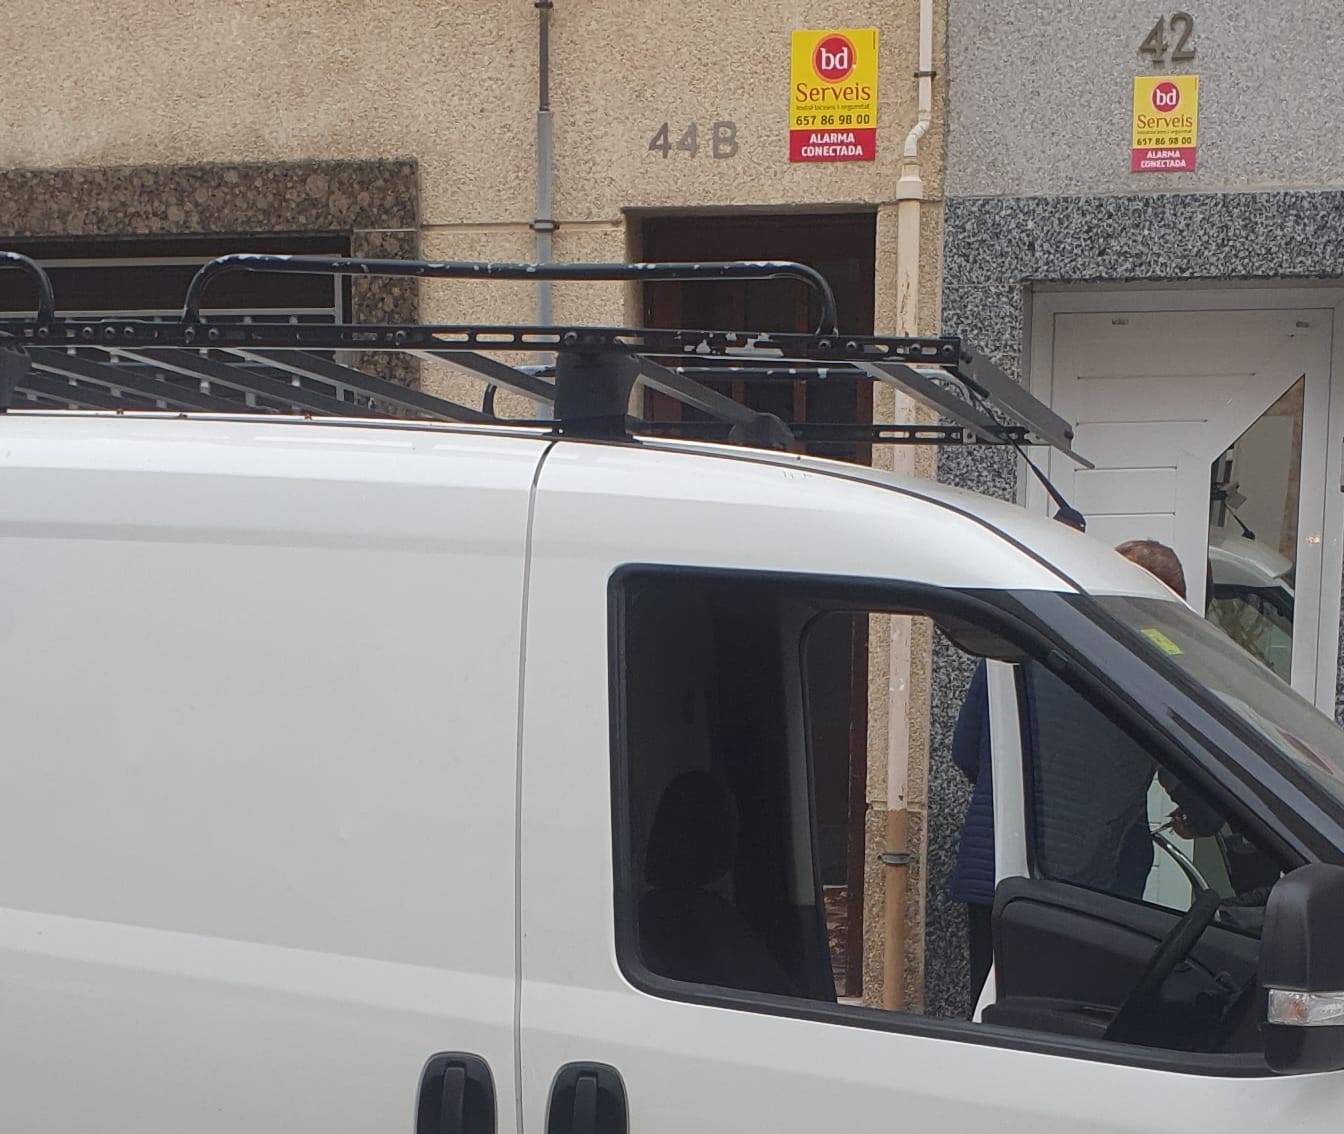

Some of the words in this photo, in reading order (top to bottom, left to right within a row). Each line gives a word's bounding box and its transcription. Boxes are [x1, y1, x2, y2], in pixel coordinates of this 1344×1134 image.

[1138, 10, 1197, 63] 42
[795, 82, 872, 103] Serveis
[795, 115, 817, 126] 657
[820, 114, 835, 125] 86
[838, 114, 853, 125] 98
[856, 113, 870, 125] 00
[1136, 113, 1193, 129] Serveis
[648, 121, 700, 160] 44
[712, 120, 739, 160] B
[809, 132, 856, 144] ALARMA
[1181, 136, 1192, 145] 00
[801, 144, 864, 157] CONECTADA
[1146, 150, 1181, 159] ALARMA
[1140, 158, 1187, 169] CONECTADA
